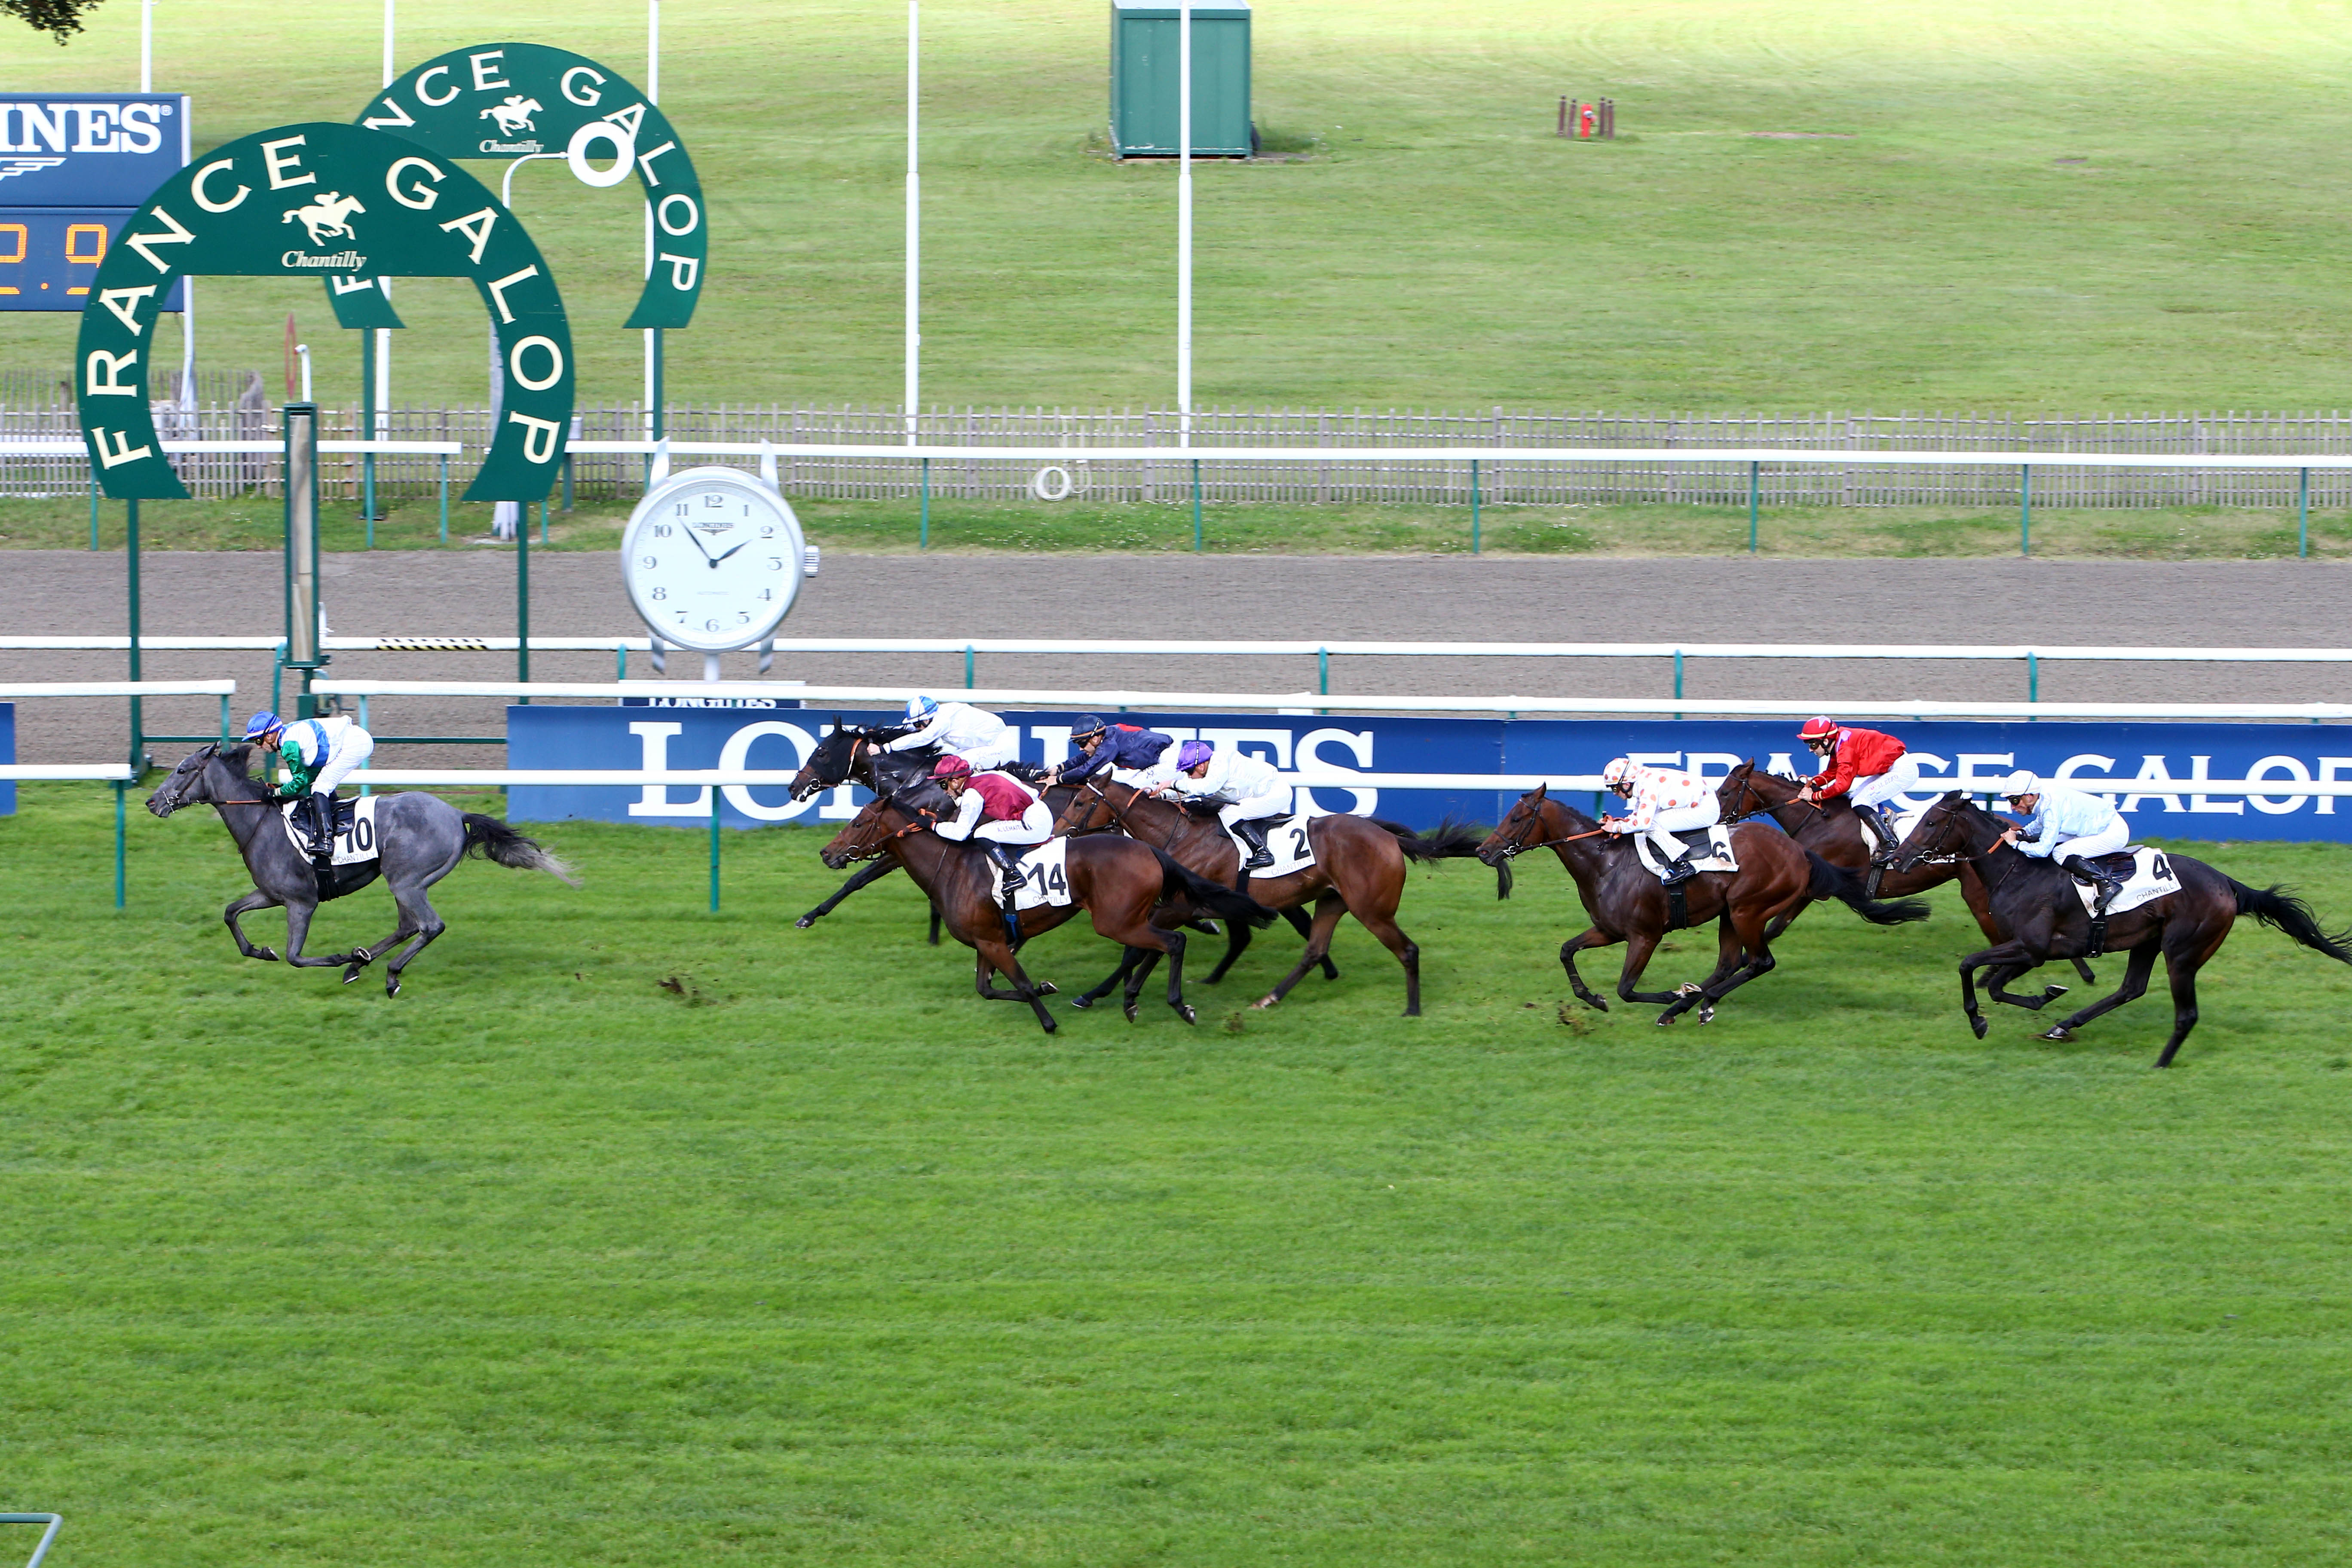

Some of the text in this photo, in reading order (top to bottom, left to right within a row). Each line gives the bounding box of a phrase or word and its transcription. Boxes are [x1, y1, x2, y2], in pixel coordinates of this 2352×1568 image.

[560, 66, 699, 291] GALOP
[281, 251, 367, 272] Chantilly
[87, 134, 564, 470] FRANCE GALOP
[704, 495, 723, 508] 12
[677, 504, 688, 516] 11
[744, 505, 749, 516] 1
[654, 524, 671, 537] 10
[760, 526, 773, 539] 2
[643, 556, 656, 569] 9
[767, 557, 782, 570] 3
[652, 587, 667, 600] 8
[757, 588, 772, 601] 4
[675, 611, 689, 623] 7
[737, 611, 750, 624] 5
[706, 619, 719, 632] 6
[346, 817, 373, 853] 10
[1289, 828, 1311, 861] 2
[337, 851, 375, 864] CHANTILLY
[1712, 841, 1731, 863] 6
[1271, 857, 1312, 875] CHANTILLY
[2153, 854, 2172, 881] 4
[1027, 863, 1066, 895] 14
[2136, 879, 2177, 901] CHANTILLY
[1033, 894, 1069, 904] CHTILLY
